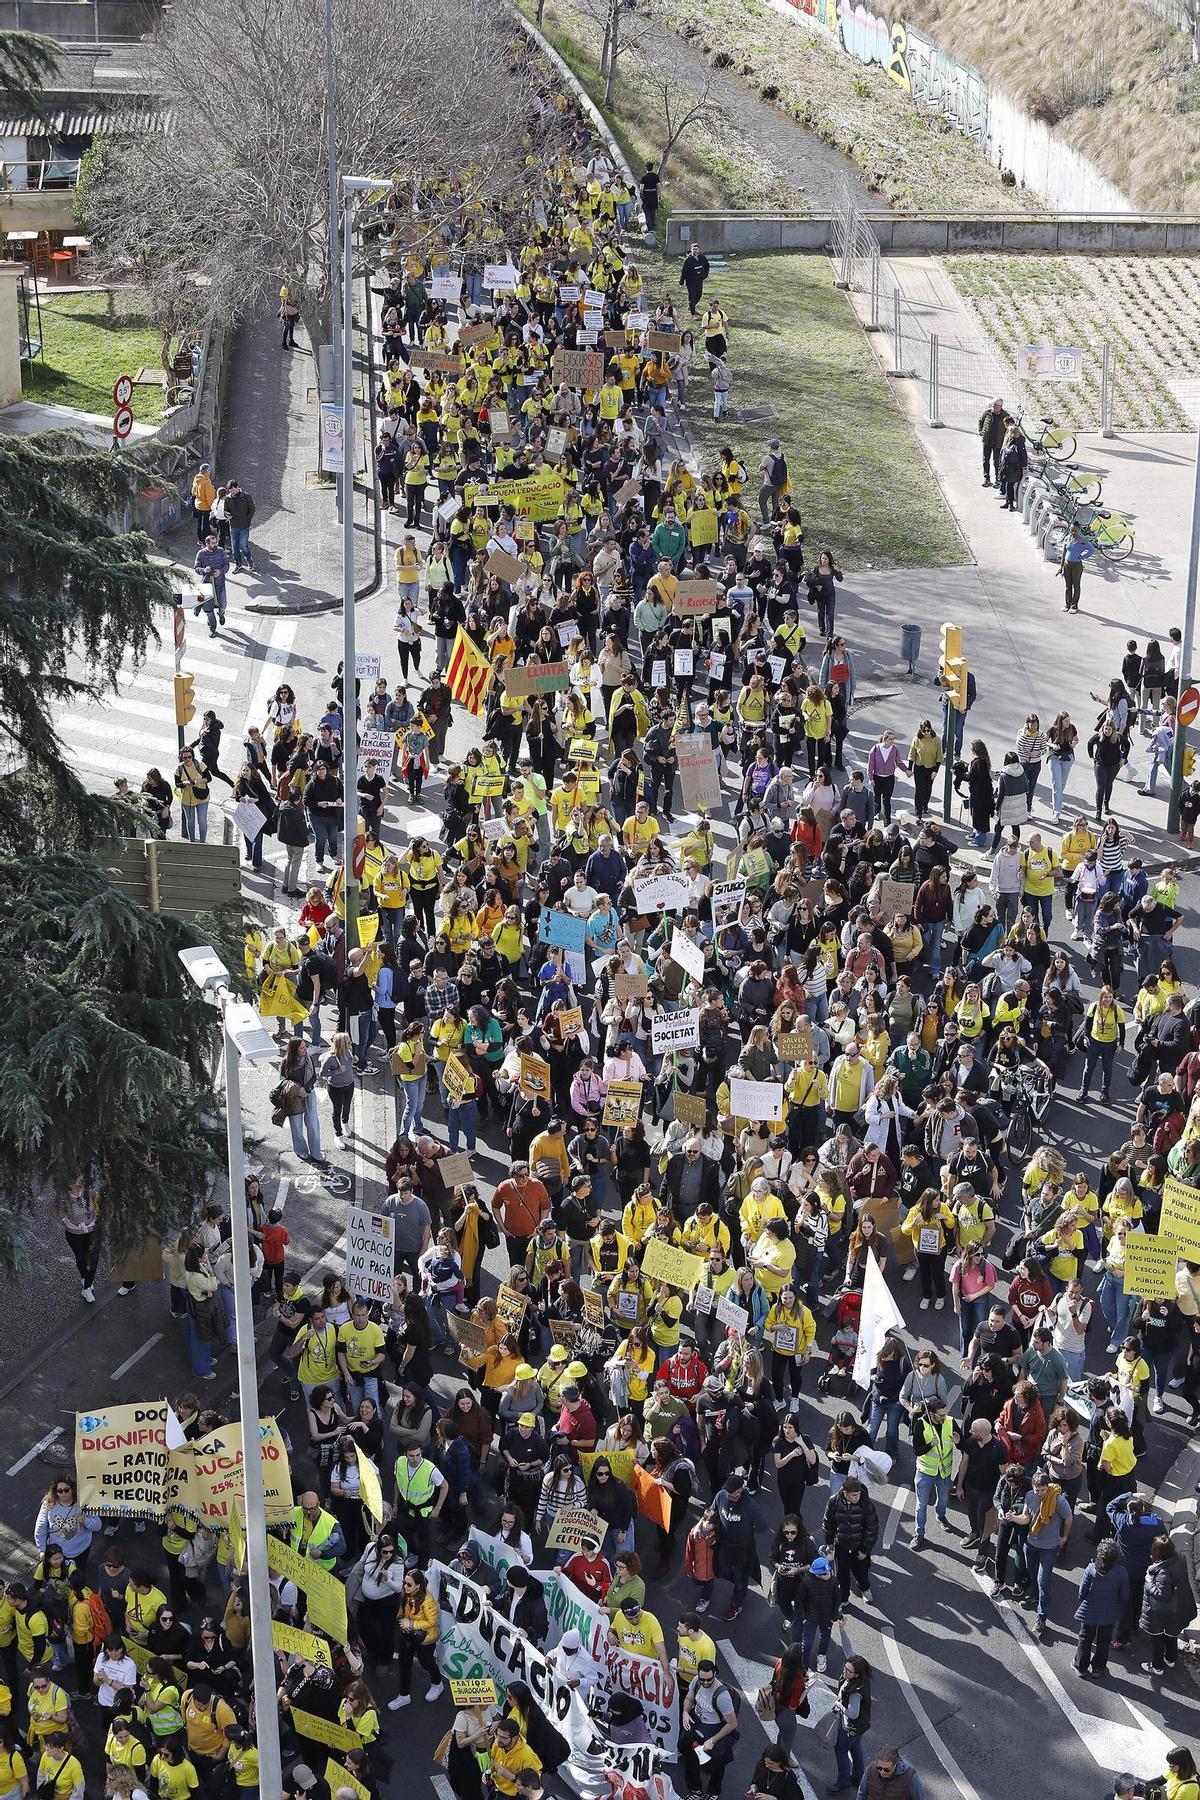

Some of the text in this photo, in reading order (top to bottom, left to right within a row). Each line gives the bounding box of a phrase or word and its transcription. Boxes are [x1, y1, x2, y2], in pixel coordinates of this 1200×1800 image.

[654, 1027, 695, 1042] SOCIETAT
[1166, 1184, 1200, 1201] ENSENYAM
[351, 1216, 366, 1232] LA
[1174, 1212, 1200, 1226] QUALITA
[350, 1236, 392, 1258] VOCACIÓ
[1126, 1244, 1177, 1256] DEPARTAMENT
[350, 1255, 392, 1278] NO PAGA
[1134, 1266, 1167, 1275] L'ESCOLA
[349, 1274, 392, 1298] FACTURES
[1136, 1276, 1165, 1286] PÚBLICA
[82, 1429, 166, 1451] DIGNIFIQ
[211, 1480, 234, 1495] 25%
[556, 1534, 566, 1544] EL
